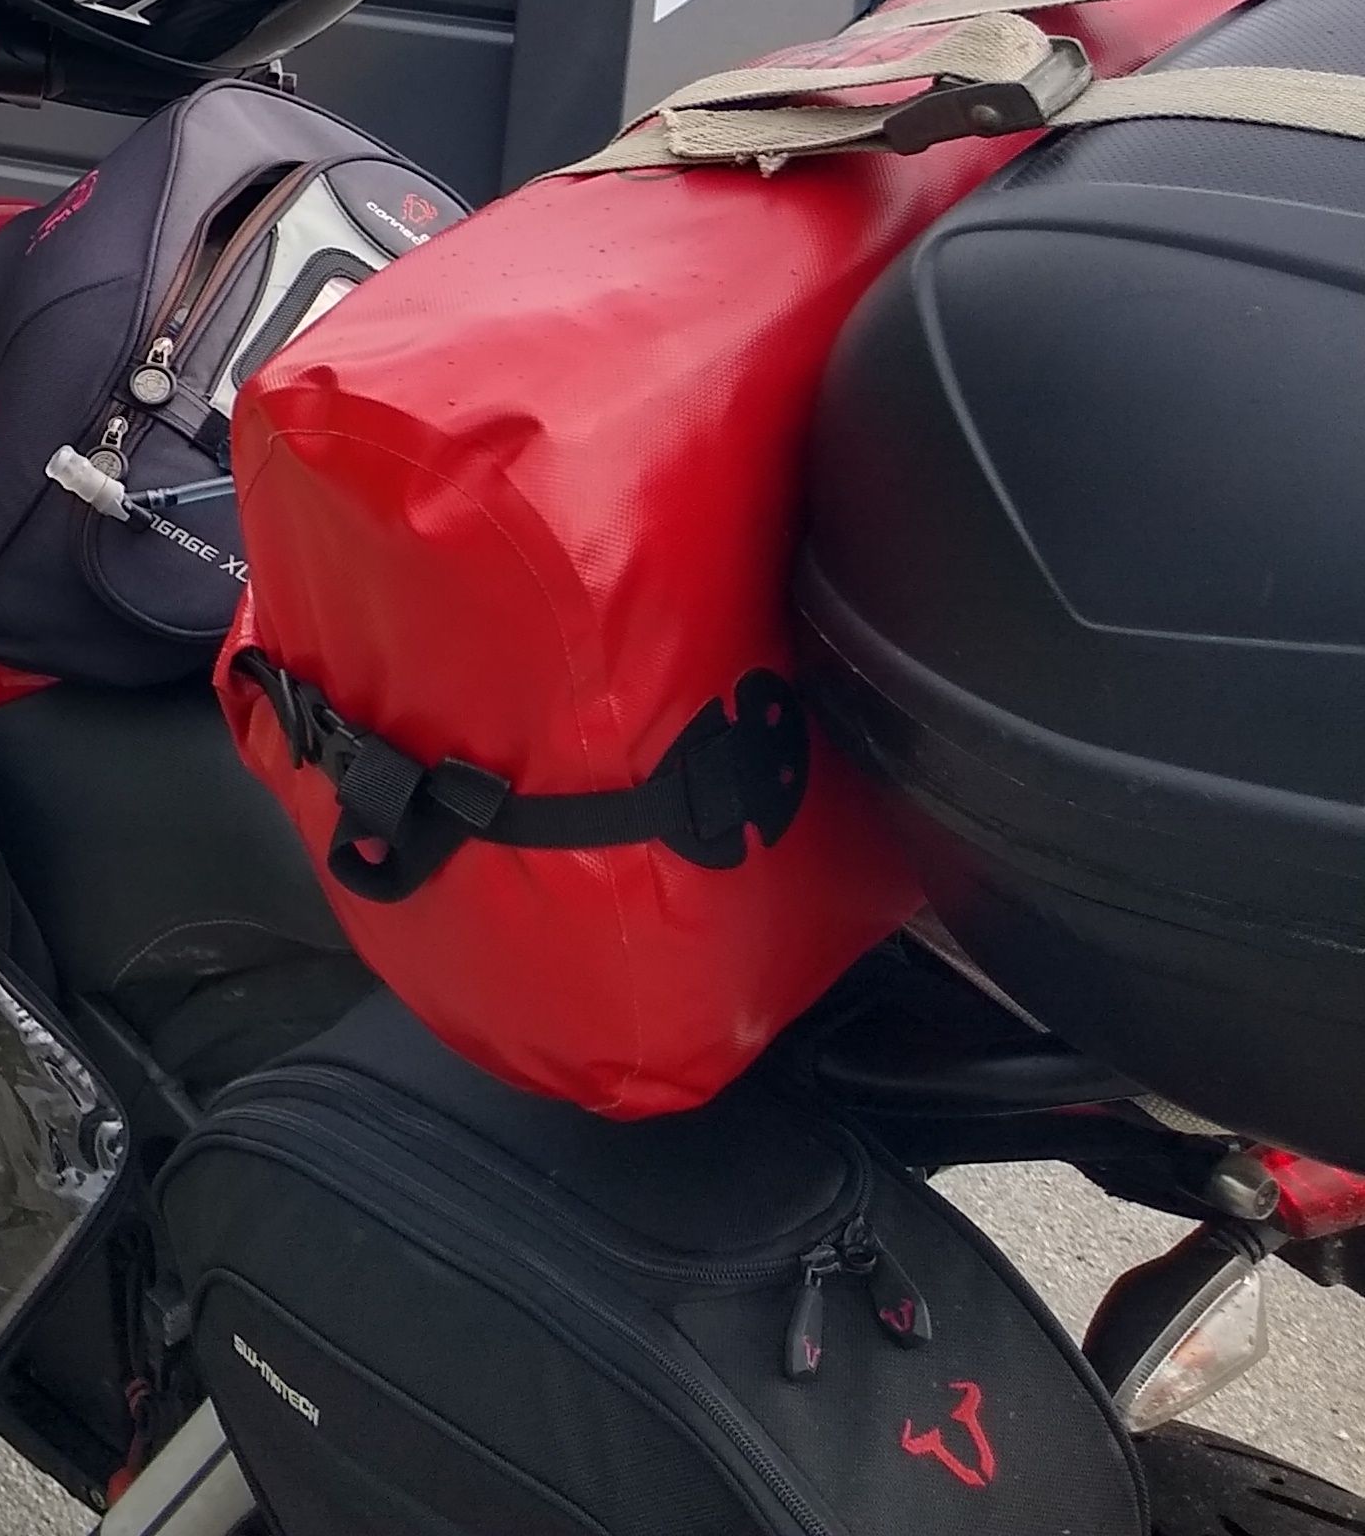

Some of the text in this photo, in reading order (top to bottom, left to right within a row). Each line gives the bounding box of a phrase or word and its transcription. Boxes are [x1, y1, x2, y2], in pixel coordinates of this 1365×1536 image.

[366, 201, 424, 246] connec
[150, 512, 250, 583] NGAGE XL
[233, 1332, 320, 1427] SW-MOTECH
